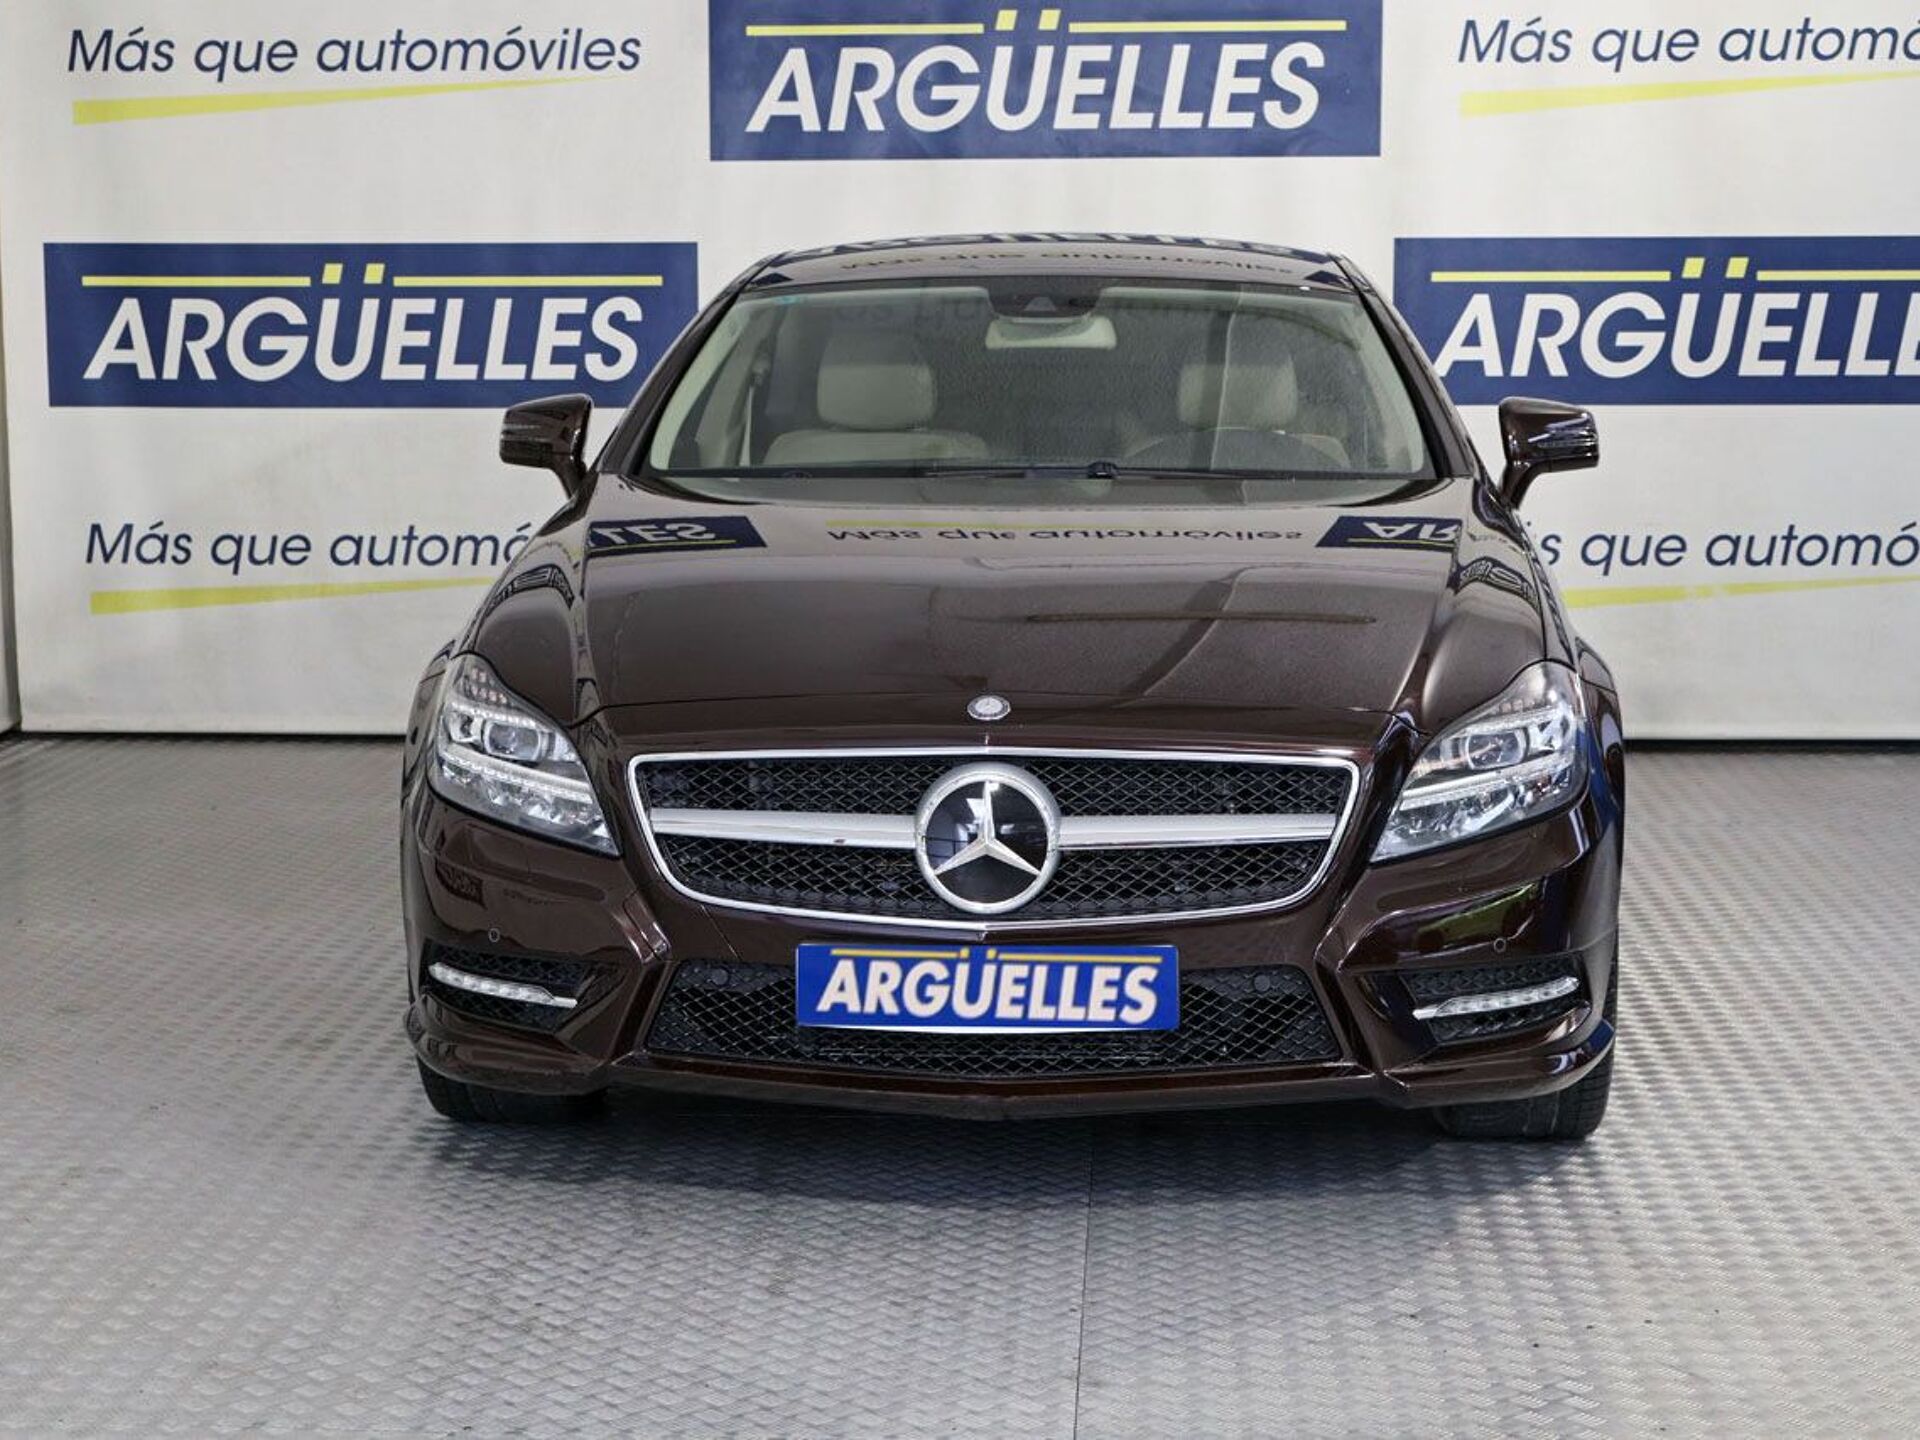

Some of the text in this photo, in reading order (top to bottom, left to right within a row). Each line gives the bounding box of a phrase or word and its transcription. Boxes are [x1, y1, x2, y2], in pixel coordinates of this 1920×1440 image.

[67, 26, 641, 83] Más que automóviles
[745, 9, 1326, 133] ARGÜELLES
[1458, 17, 1573, 63] Más
[1592, 27, 1699, 73] que
[83, 263, 643, 382] ARGÜELLES
[86, 521, 193, 566] Más
[210, 532, 312, 576] que
[1580, 533, 1687, 577] que
[1705, 521, 1920, 567] automó
[815, 948, 1158, 1024] ARGÜELLES
